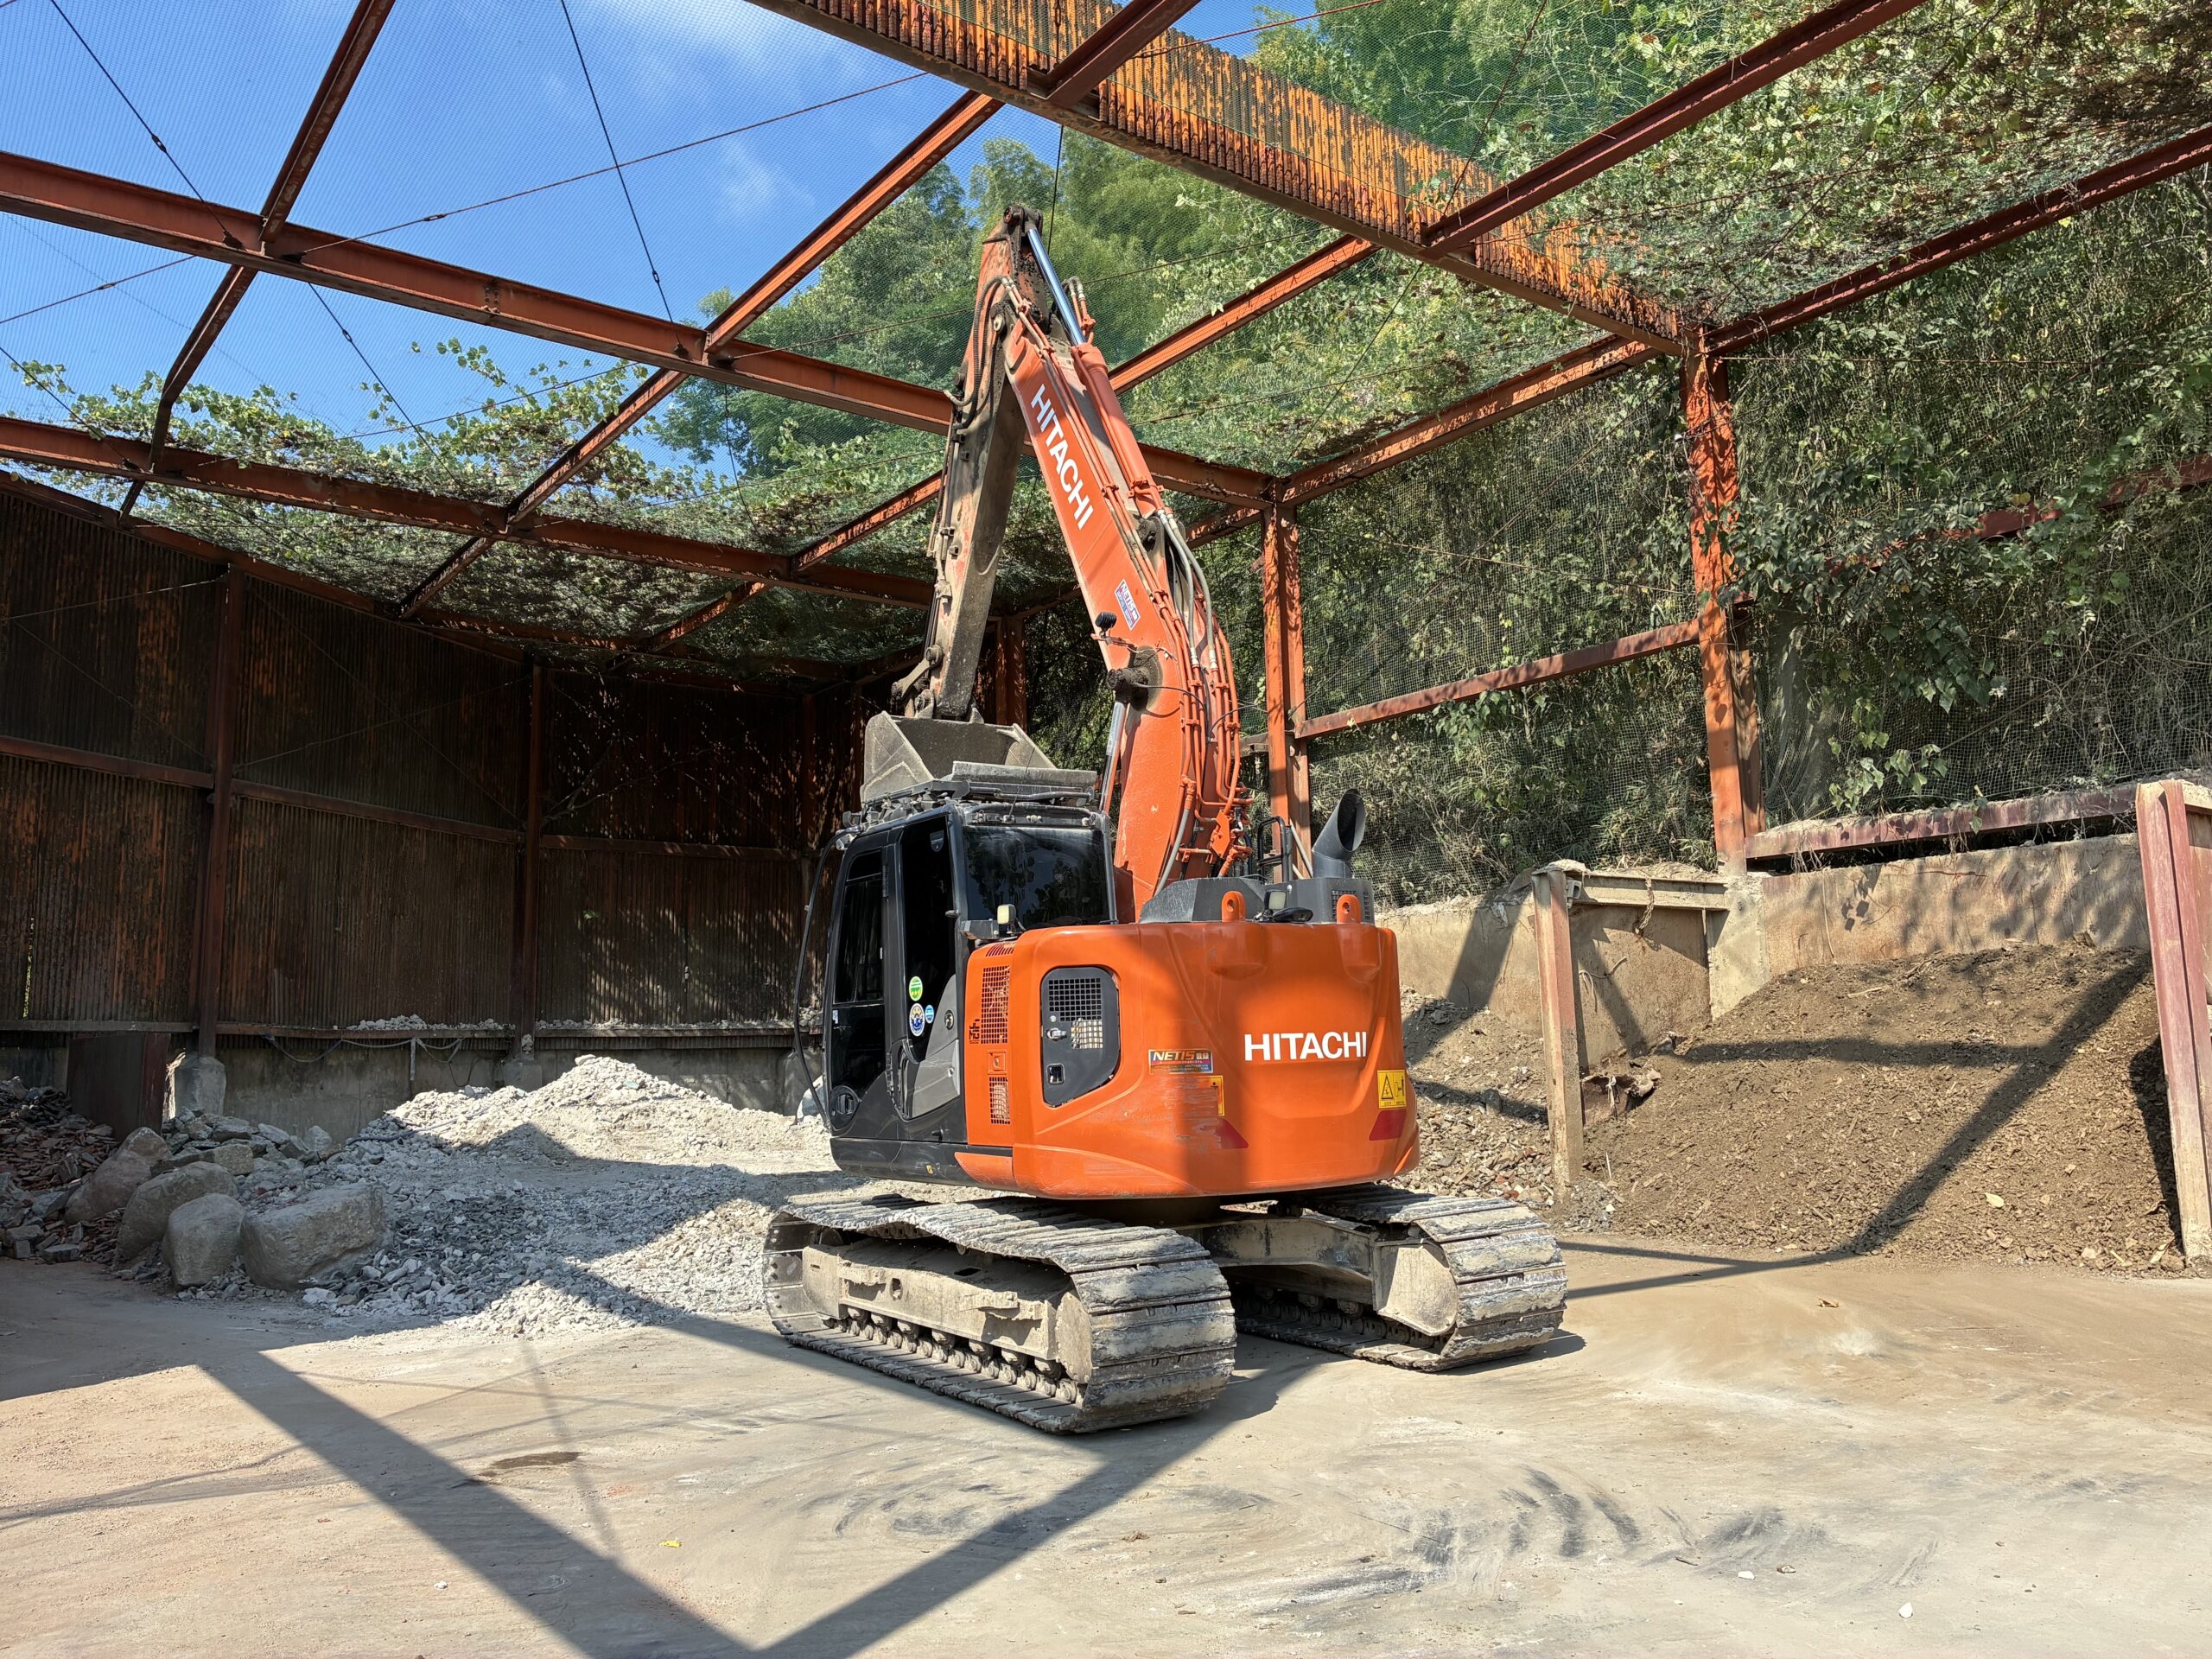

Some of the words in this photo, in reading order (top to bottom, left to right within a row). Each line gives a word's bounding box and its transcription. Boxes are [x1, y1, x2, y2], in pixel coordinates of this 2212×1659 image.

[1031, 384, 1094, 531] HITACHI
[1120, 584, 1135, 612] NETIS
[1153, 1051, 1195, 1061] NETIS
[1244, 1032, 1367, 1061] HITACHI
